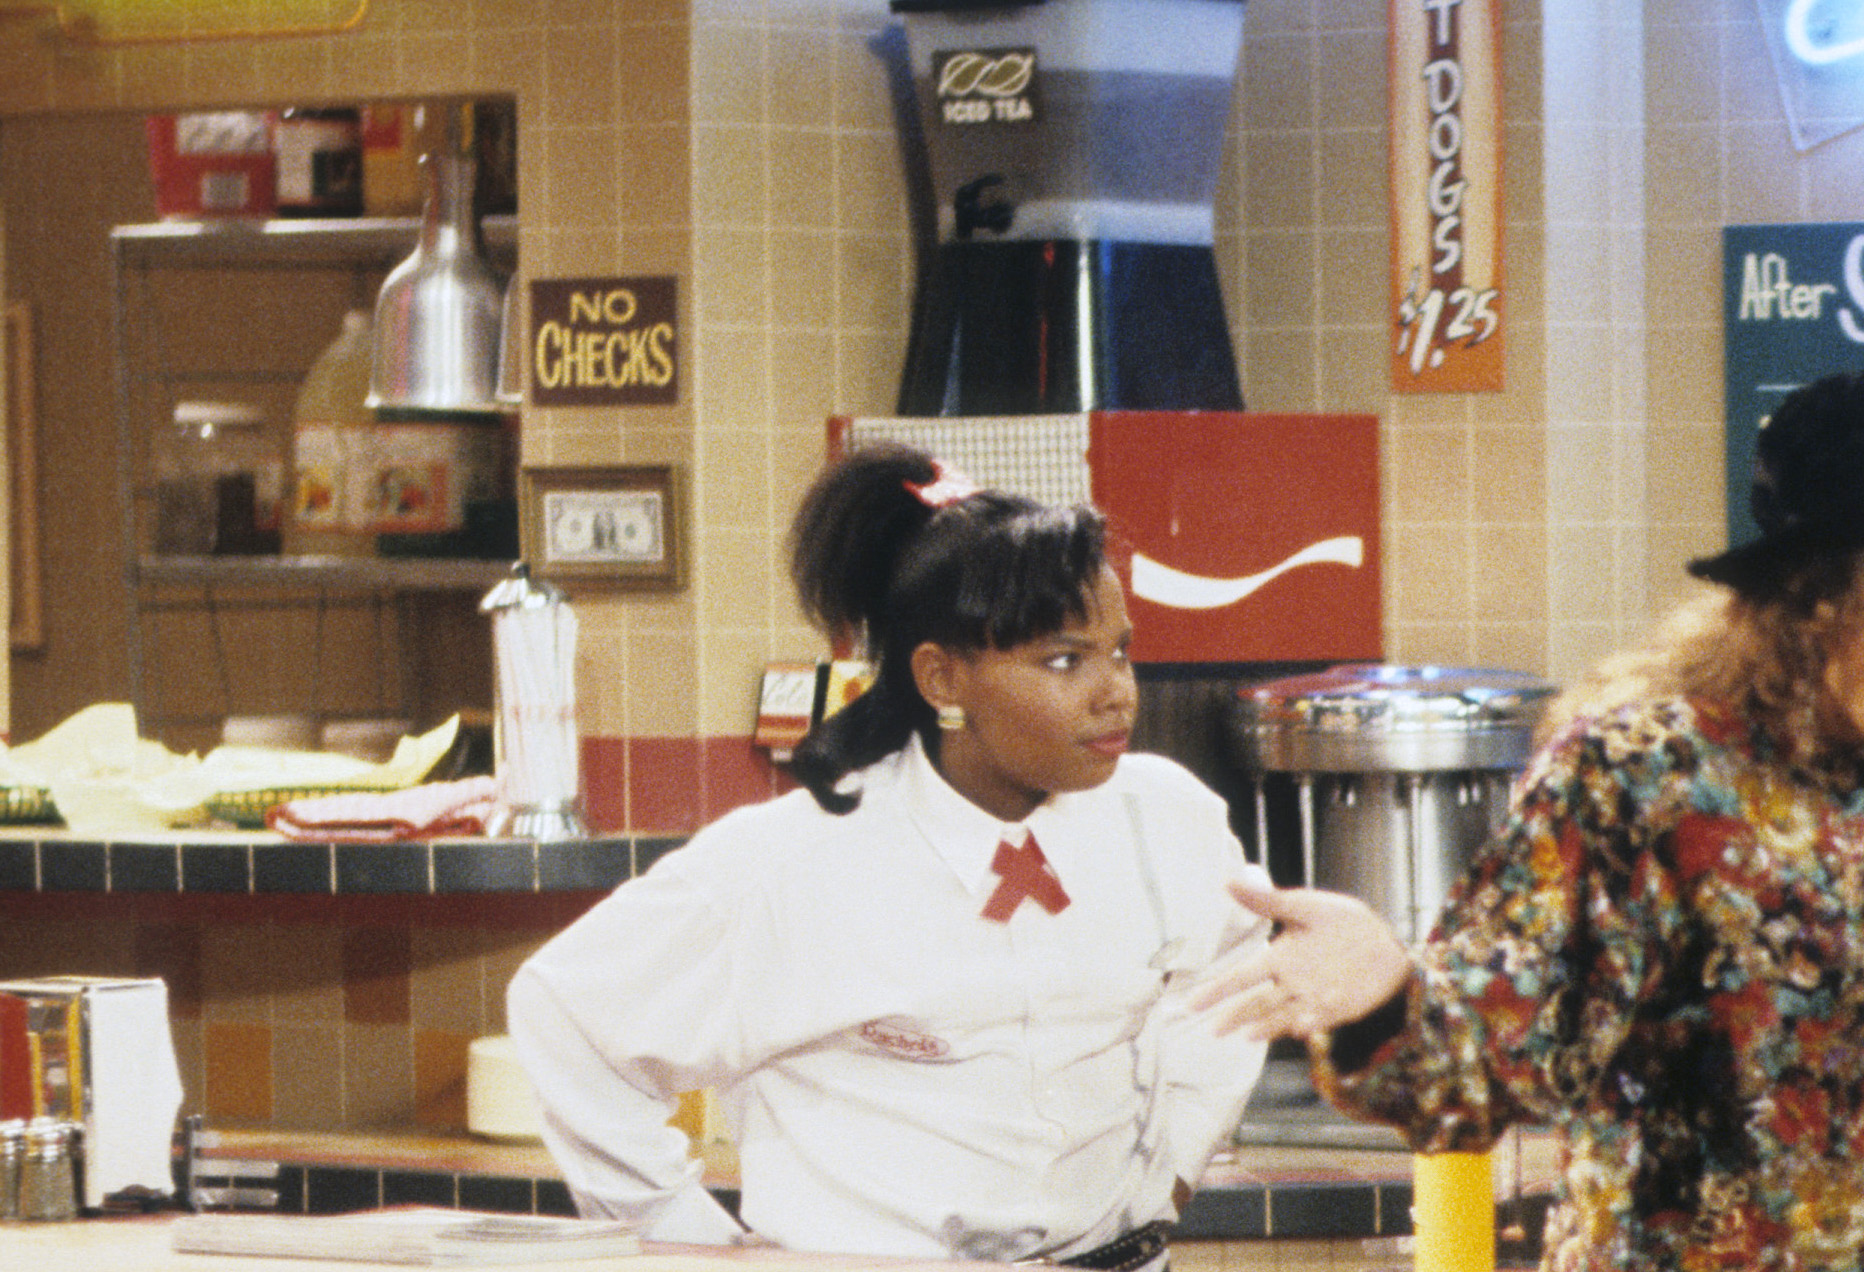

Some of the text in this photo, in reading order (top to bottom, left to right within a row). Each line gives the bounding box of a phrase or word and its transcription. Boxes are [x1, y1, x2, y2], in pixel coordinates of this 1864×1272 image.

[943, 99, 1032, 123] ICED TEA
[1424, 59, 1467, 273] DOGS
[570, 289, 637, 324] NO
[1739, 252, 1836, 320] After
[536, 321, 673, 388] CHECKS
